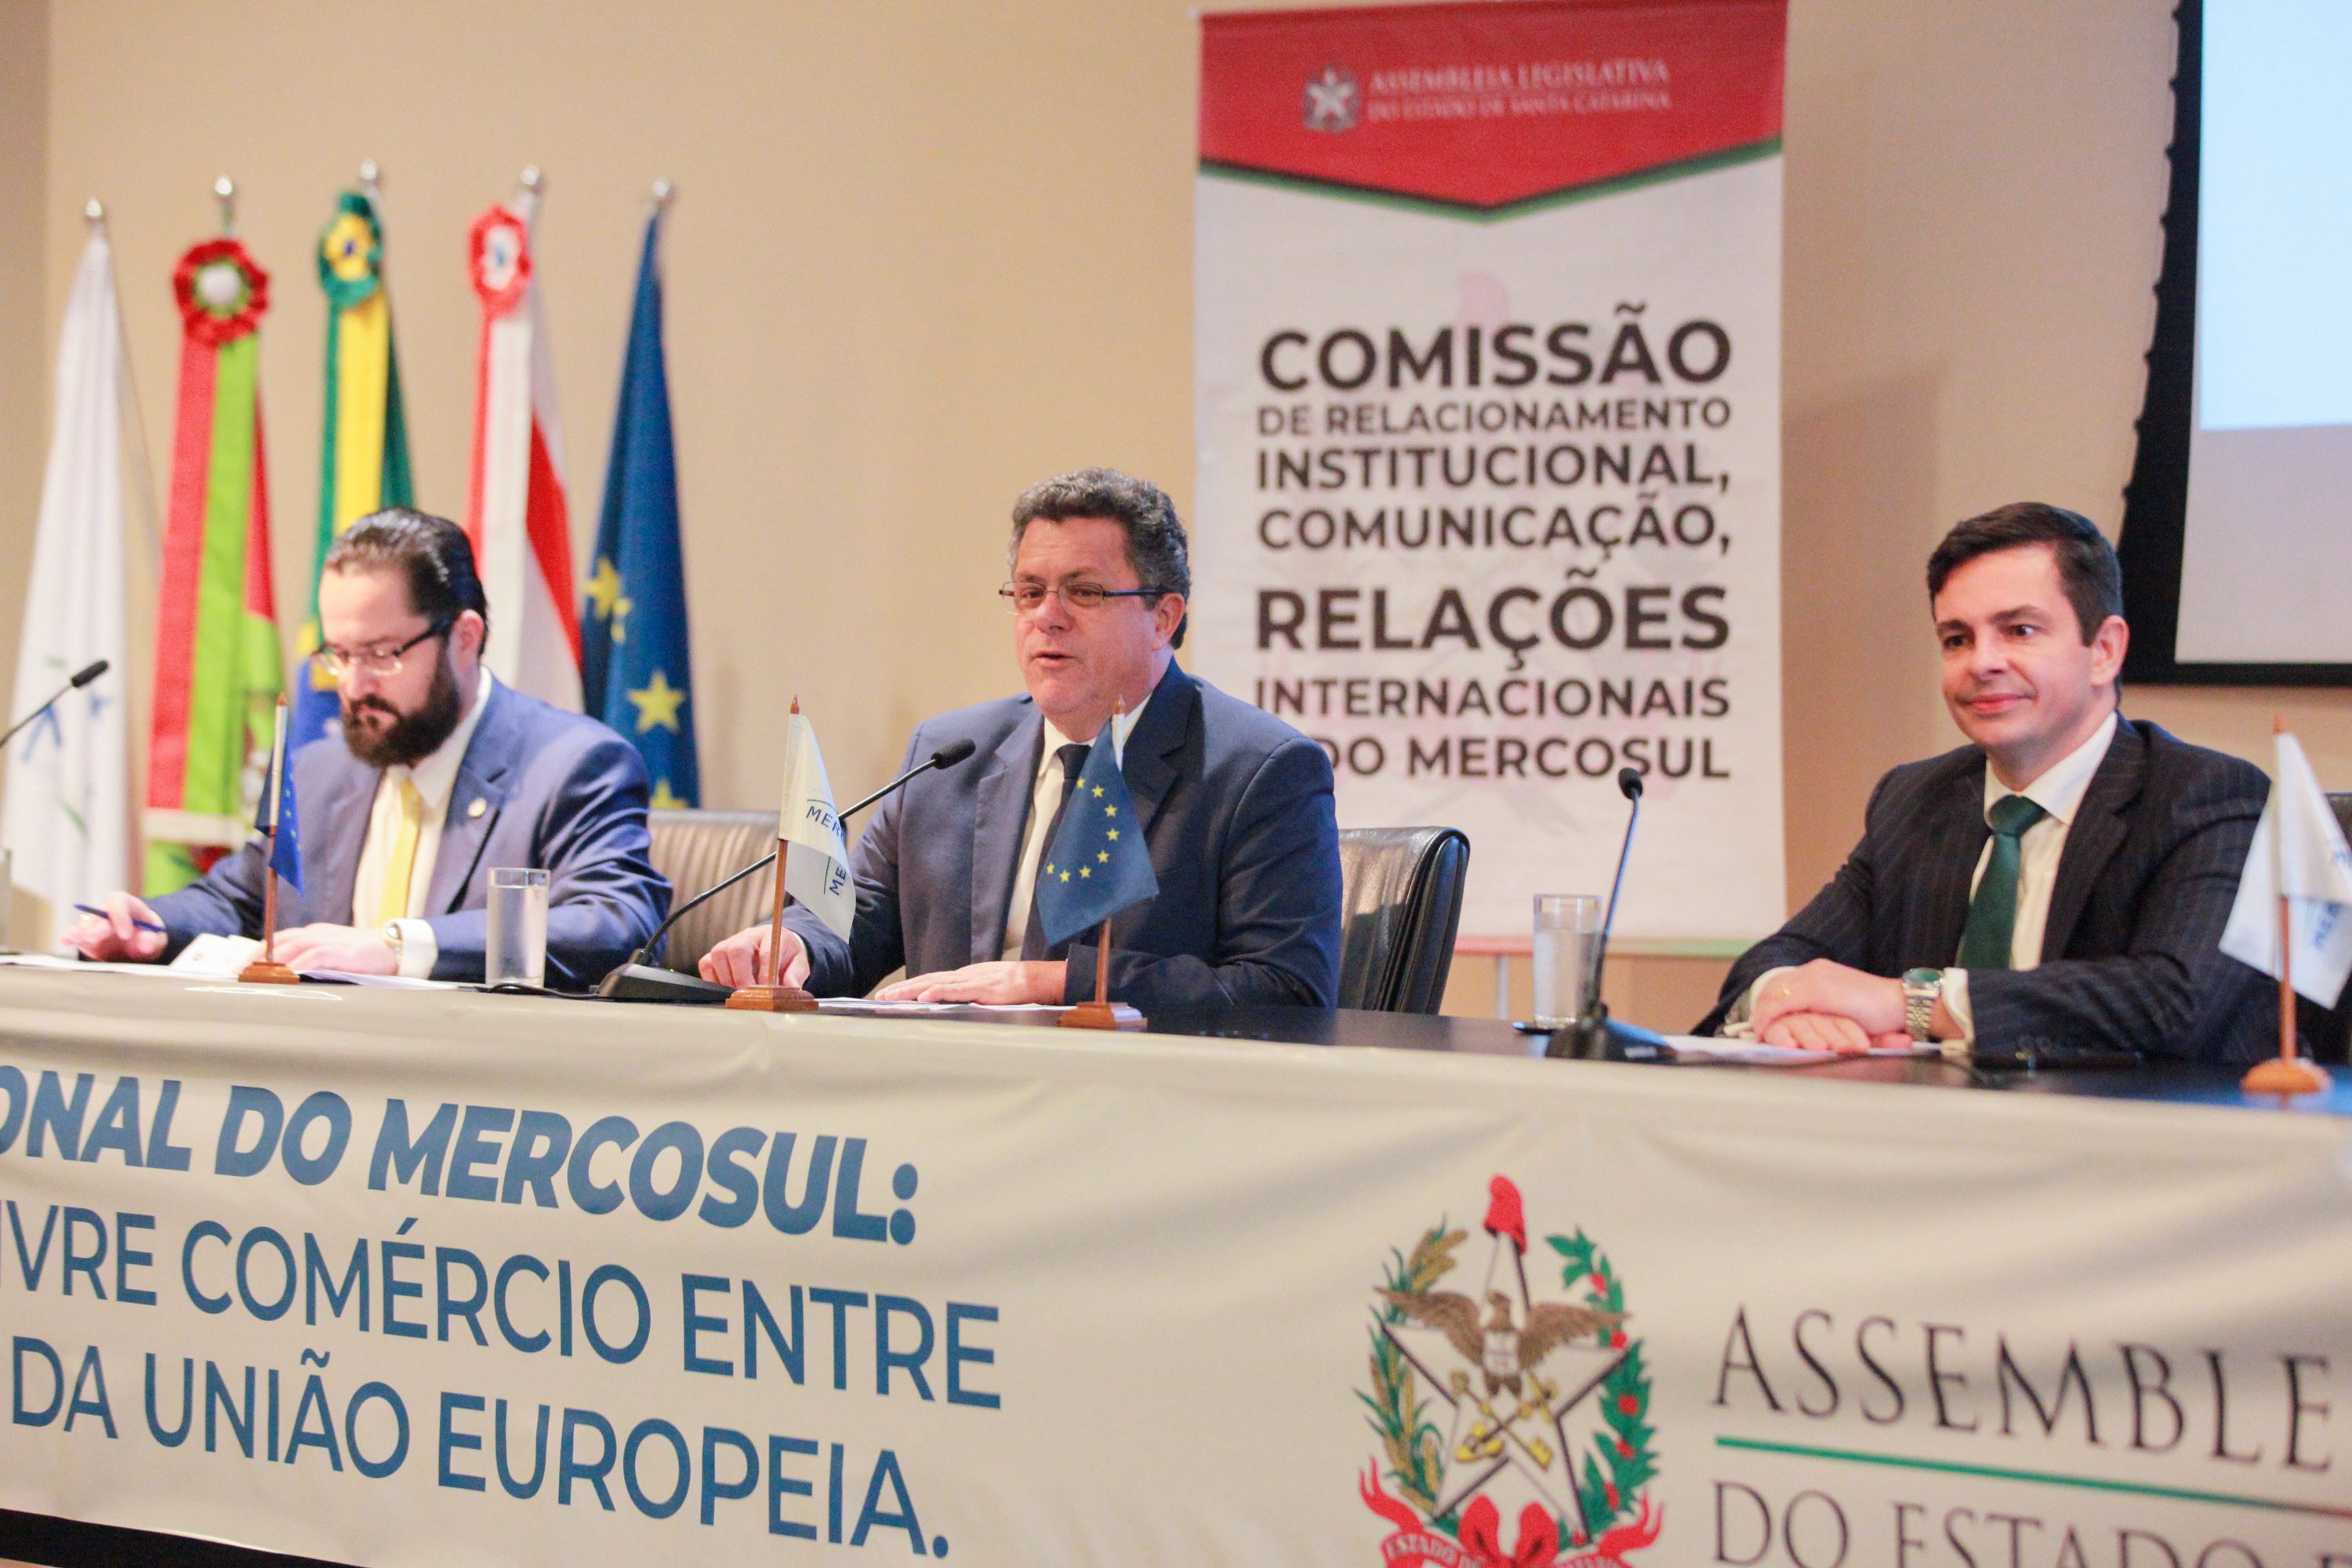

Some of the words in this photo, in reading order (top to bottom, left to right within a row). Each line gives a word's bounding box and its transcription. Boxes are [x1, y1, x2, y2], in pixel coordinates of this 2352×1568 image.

[1258, 301, 1733, 393] COMISSÃO
[1257, 405, 1312, 437] DE
[1326, 397, 1732, 435] RELACIONAMENTO
[1257, 441, 1732, 494] INSTITUCIONAL,
[1257, 491, 1732, 561] COMUNICAÇÃO,
[1257, 566, 1731, 673] RELAÇÕES
[1256, 677, 1731, 719] INTERNACIONAIS
[1406, 736, 1731, 779] MERCOSUL
[214, 1084, 353, 1186] DO
[367, 1098, 918, 1246] MERCOSUL:
[0, 1199, 158, 1307] VRE
[181, 1216, 652, 1366] COMÉRCIO
[681, 1272, 1002, 1410] ENTRE
[1711, 1304, 2335, 1474] ASSEMBLE
[12, 1335, 119, 1440] DA
[144, 1347, 411, 1479] UNIÃO
[437, 1391, 949, 1559] EUROPEIA.
[1711, 1480, 1851, 1568] DO
